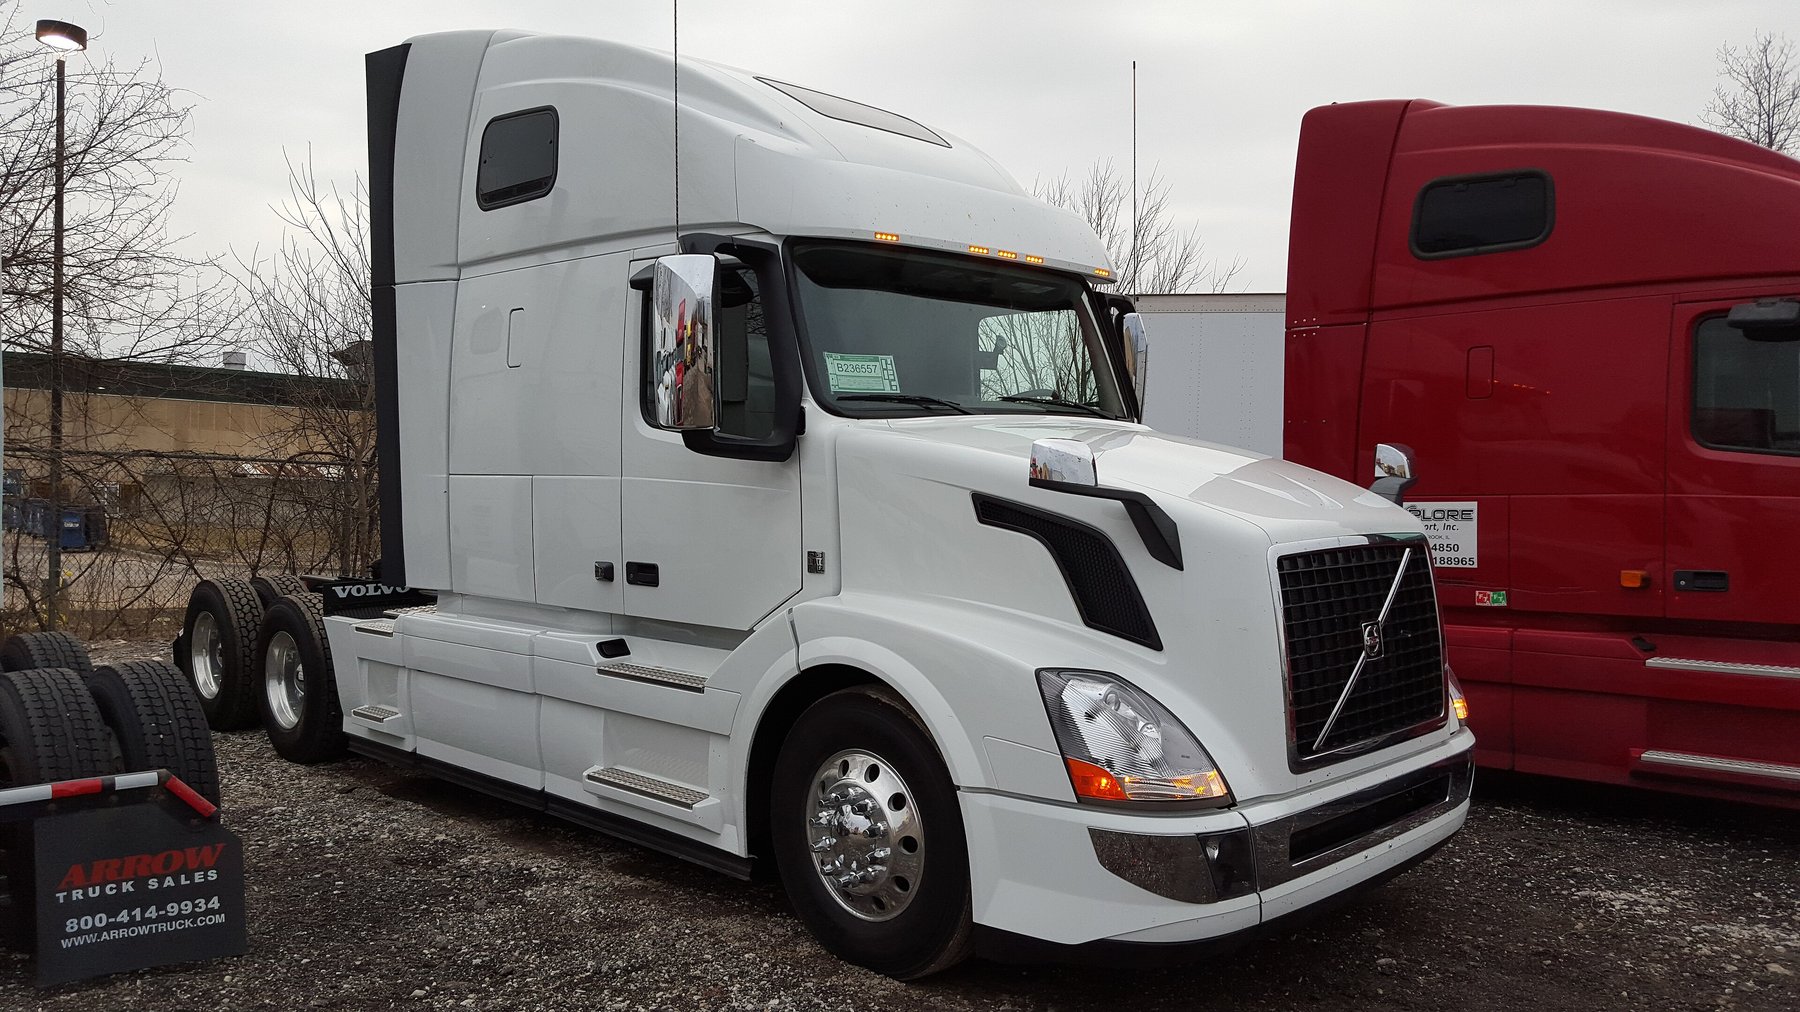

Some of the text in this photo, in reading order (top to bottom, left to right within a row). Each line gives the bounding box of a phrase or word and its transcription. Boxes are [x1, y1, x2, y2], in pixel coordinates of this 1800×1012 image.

[836, 362, 878, 374] B236557
[1408, 509, 1474, 521] PLORE
[1424, 523, 1459, 532] ort, Inc.
[1431, 543, 1460, 552] 4850
[1433, 556, 1475, 566] 188965
[55, 843, 227, 891] ARROW
[56, 869, 219, 903] TRUCK SALES
[65, 895, 221, 933] 800-414-9934
[61, 913, 226, 949] WWW.ARROWTRUCK.COM
